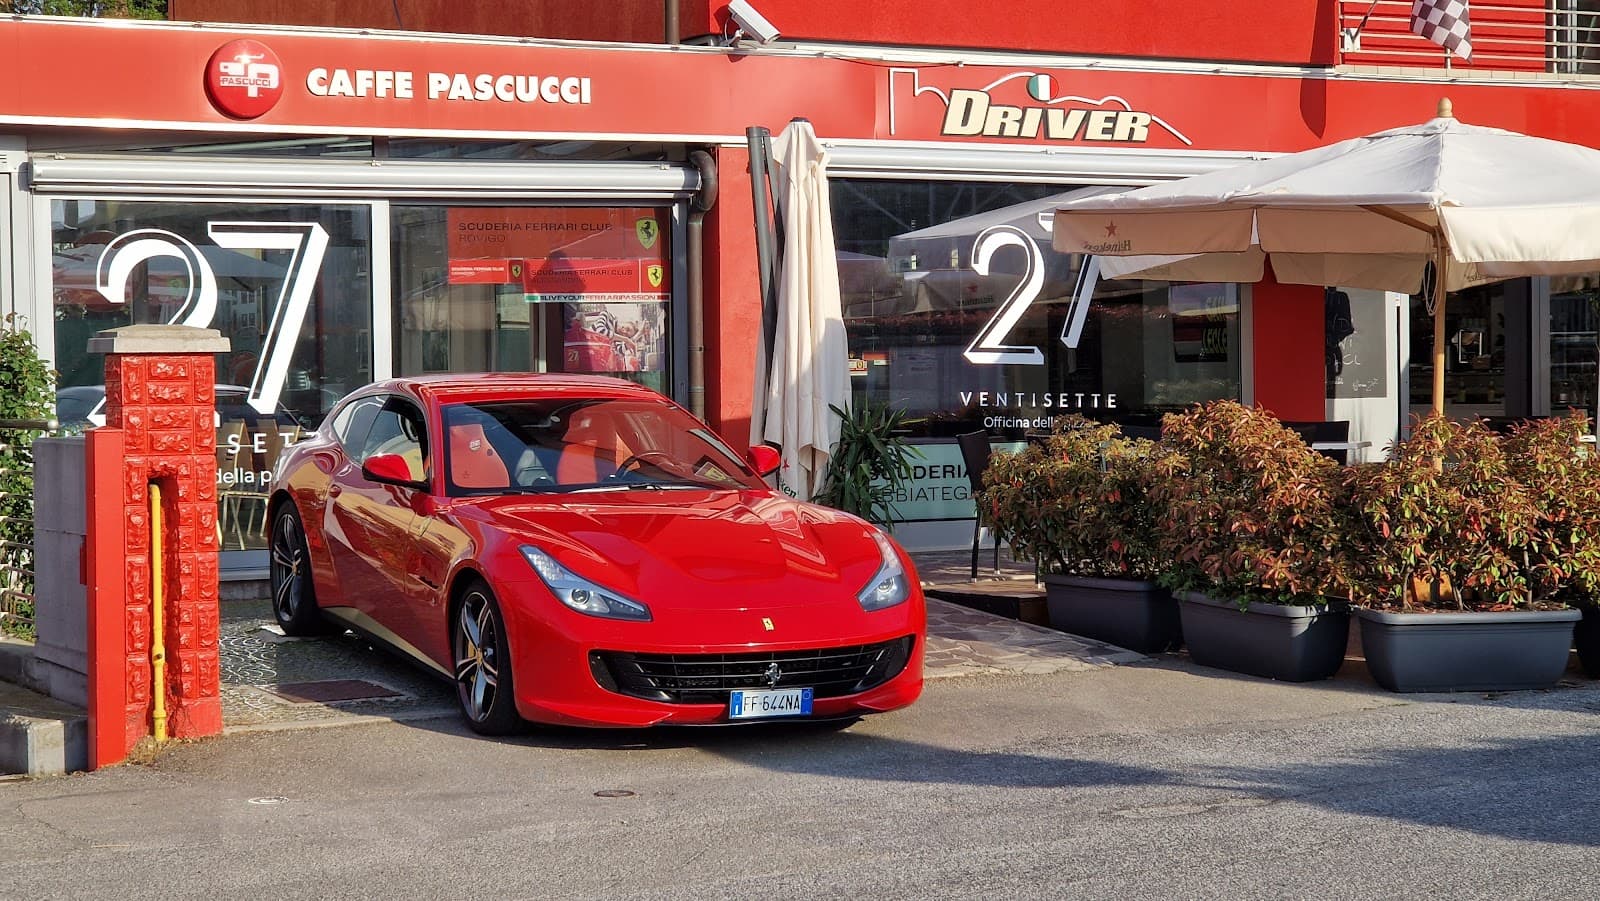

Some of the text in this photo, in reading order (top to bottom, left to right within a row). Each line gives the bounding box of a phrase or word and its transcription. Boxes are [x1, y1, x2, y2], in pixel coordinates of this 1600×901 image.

[221, 77, 271, 87] PASCUCCI
[306, 68, 592, 104] CAFFE PASCUCCI
[942, 89, 1152, 142] DRIVER
[458, 222, 613, 231] SCUDERIA FERRARI CLUB
[458, 233, 506, 243] ROVIGO
[963, 212, 1101, 365] 27
[960, 391, 1117, 409] VENTISETTE
[983, 416, 1030, 428] Officina
[1032, 416, 1053, 428] dell
[870, 464, 970, 481] UDERI
[870, 486, 971, 503] BBIATEG
[762, 694, 800, 711] 644NA
